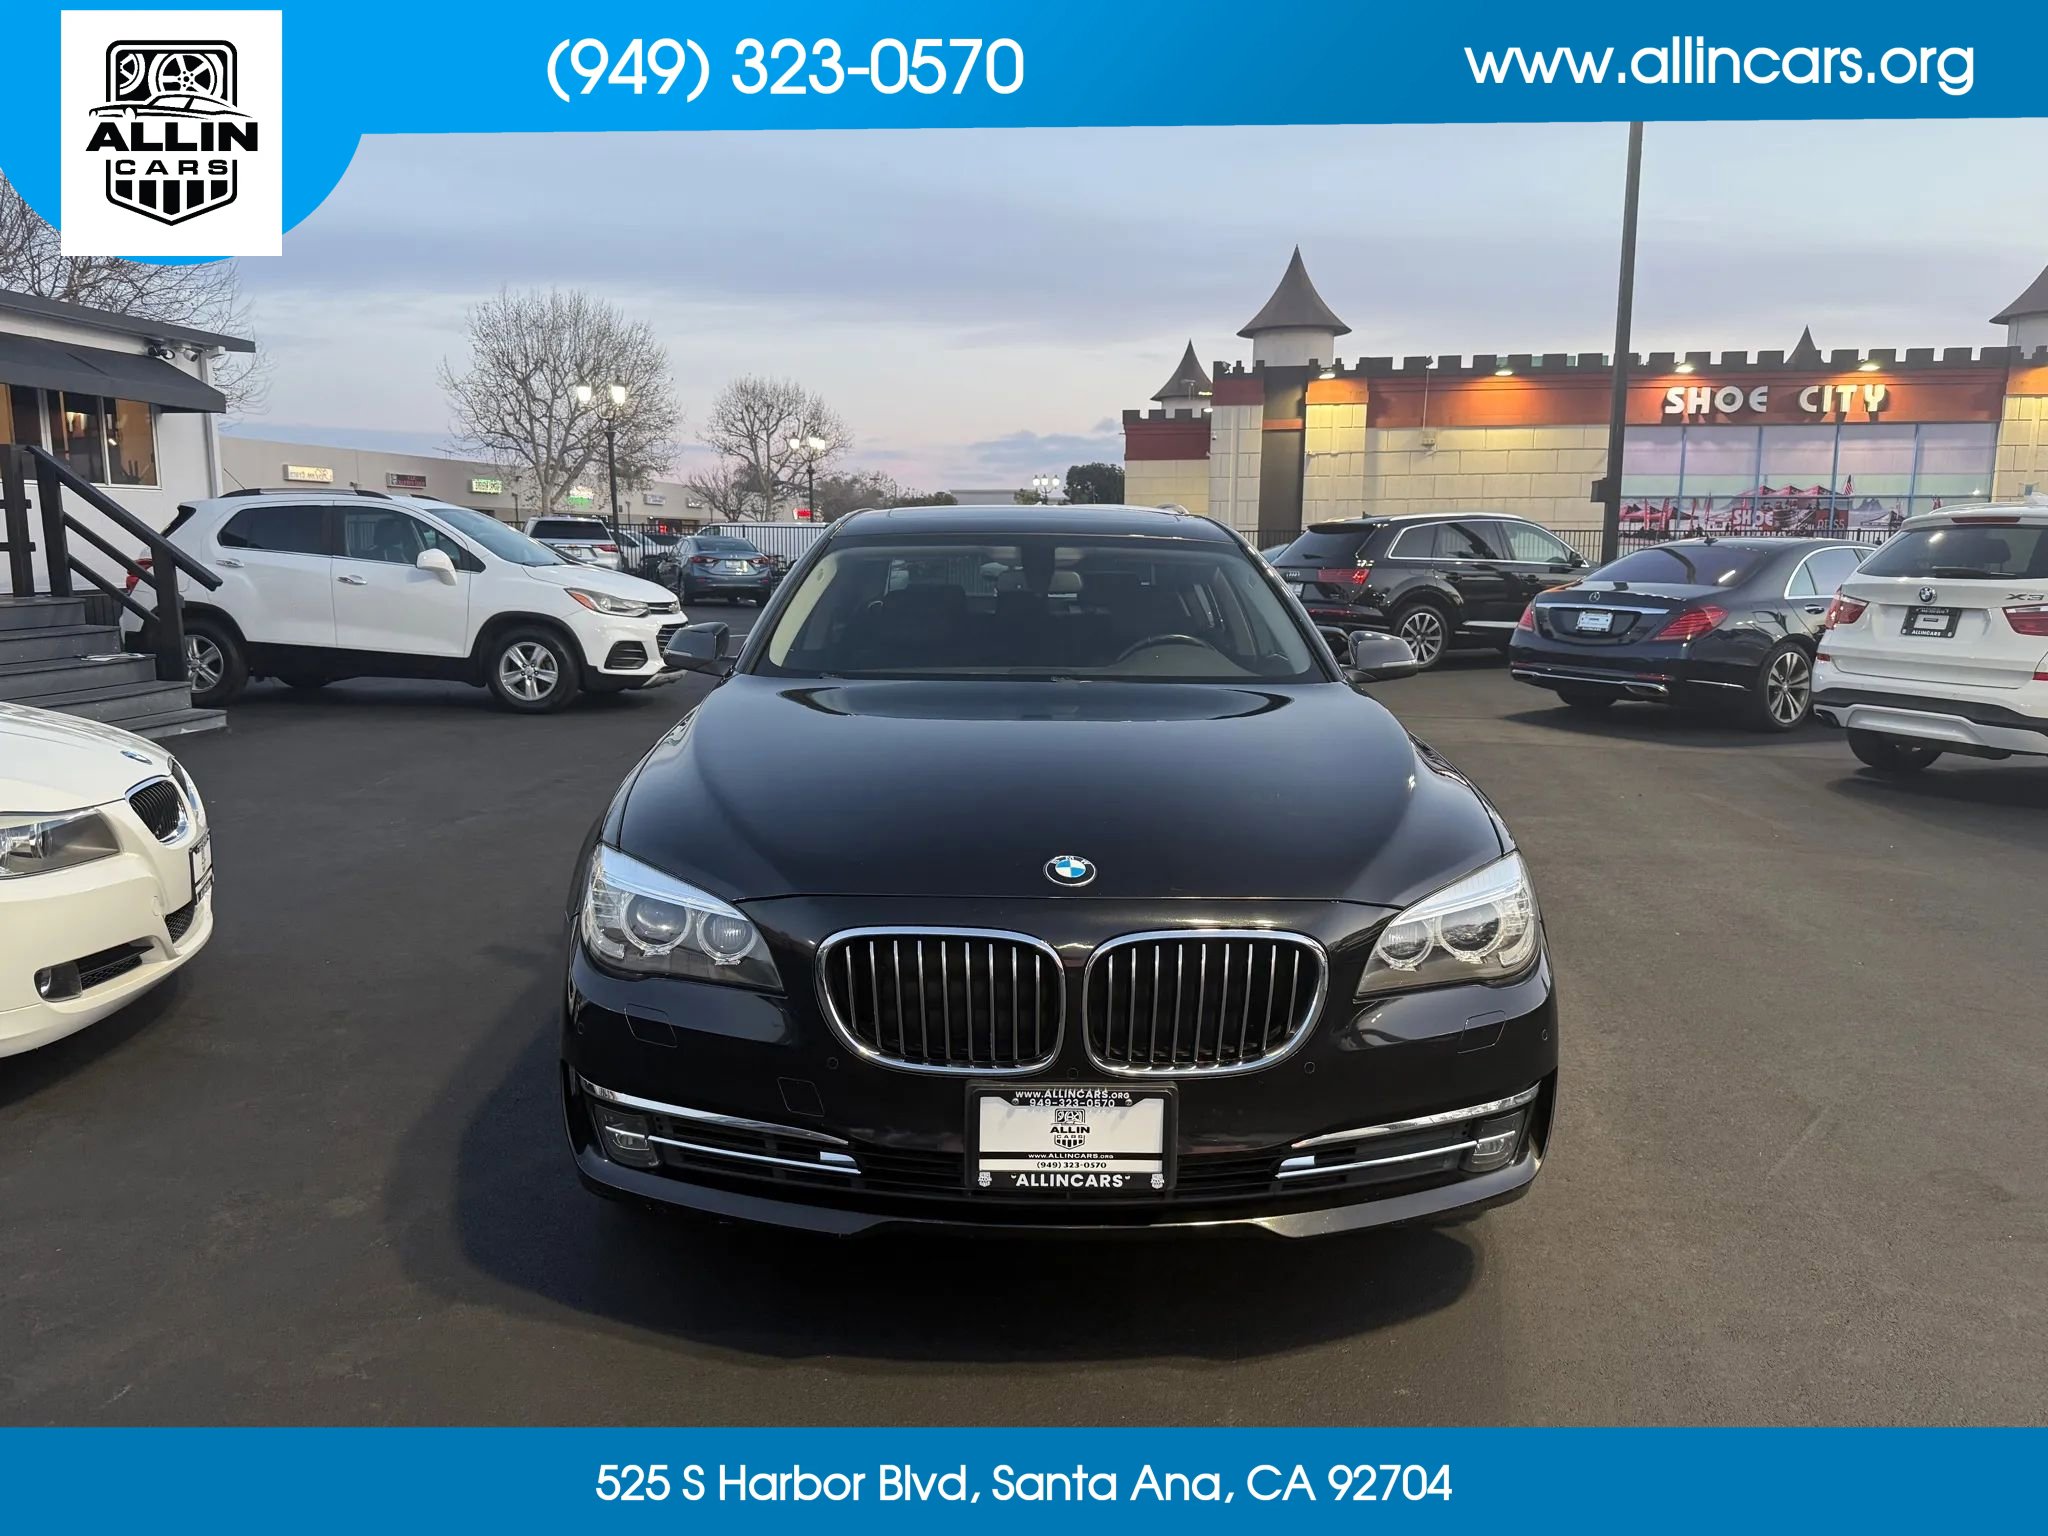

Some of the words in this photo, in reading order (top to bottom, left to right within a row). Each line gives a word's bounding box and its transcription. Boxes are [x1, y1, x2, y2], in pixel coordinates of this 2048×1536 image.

[1664, 385, 1768, 414] SHOE
[1799, 384, 1885, 412] CITY
[1029, 1099, 1115, 1107] 949-323-0570
[1036, 1161, 1061, 1169] (949)
